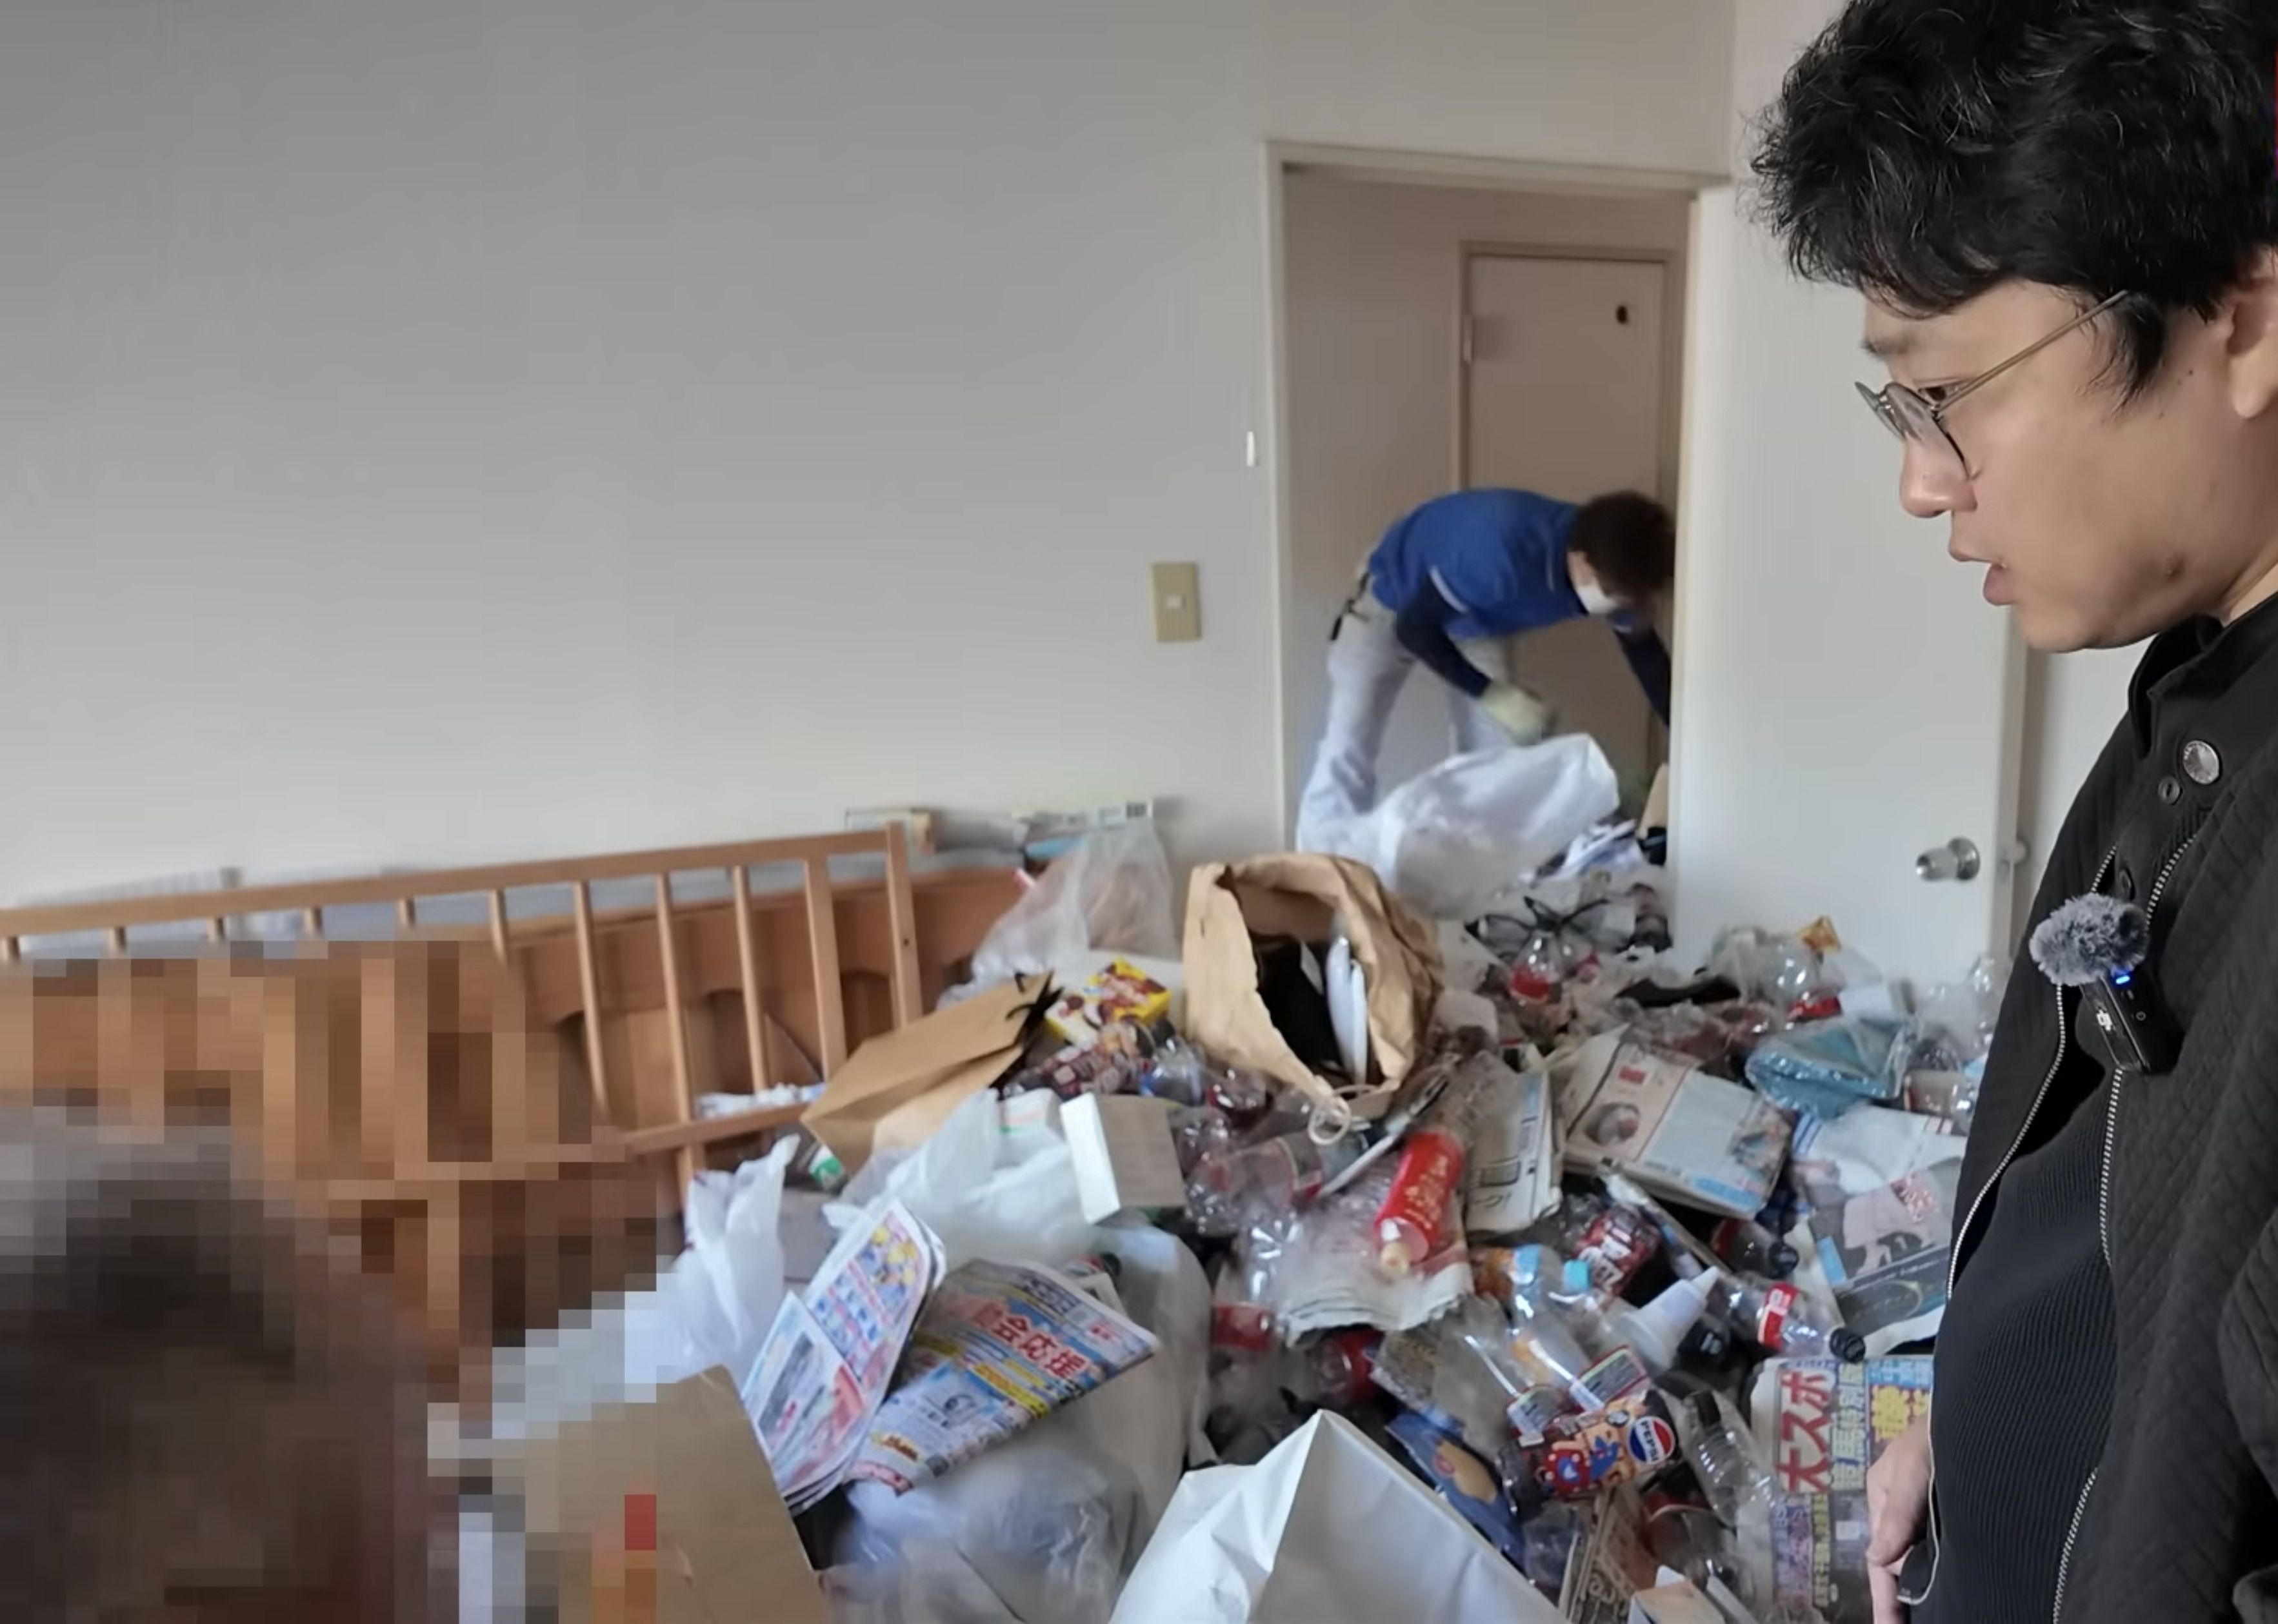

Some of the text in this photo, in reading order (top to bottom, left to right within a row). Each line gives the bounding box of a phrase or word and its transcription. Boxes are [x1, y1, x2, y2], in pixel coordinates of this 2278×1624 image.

[1640, 1420, 1659, 1462] PEPSI
[1774, 1371, 1832, 1492] 大スポ
